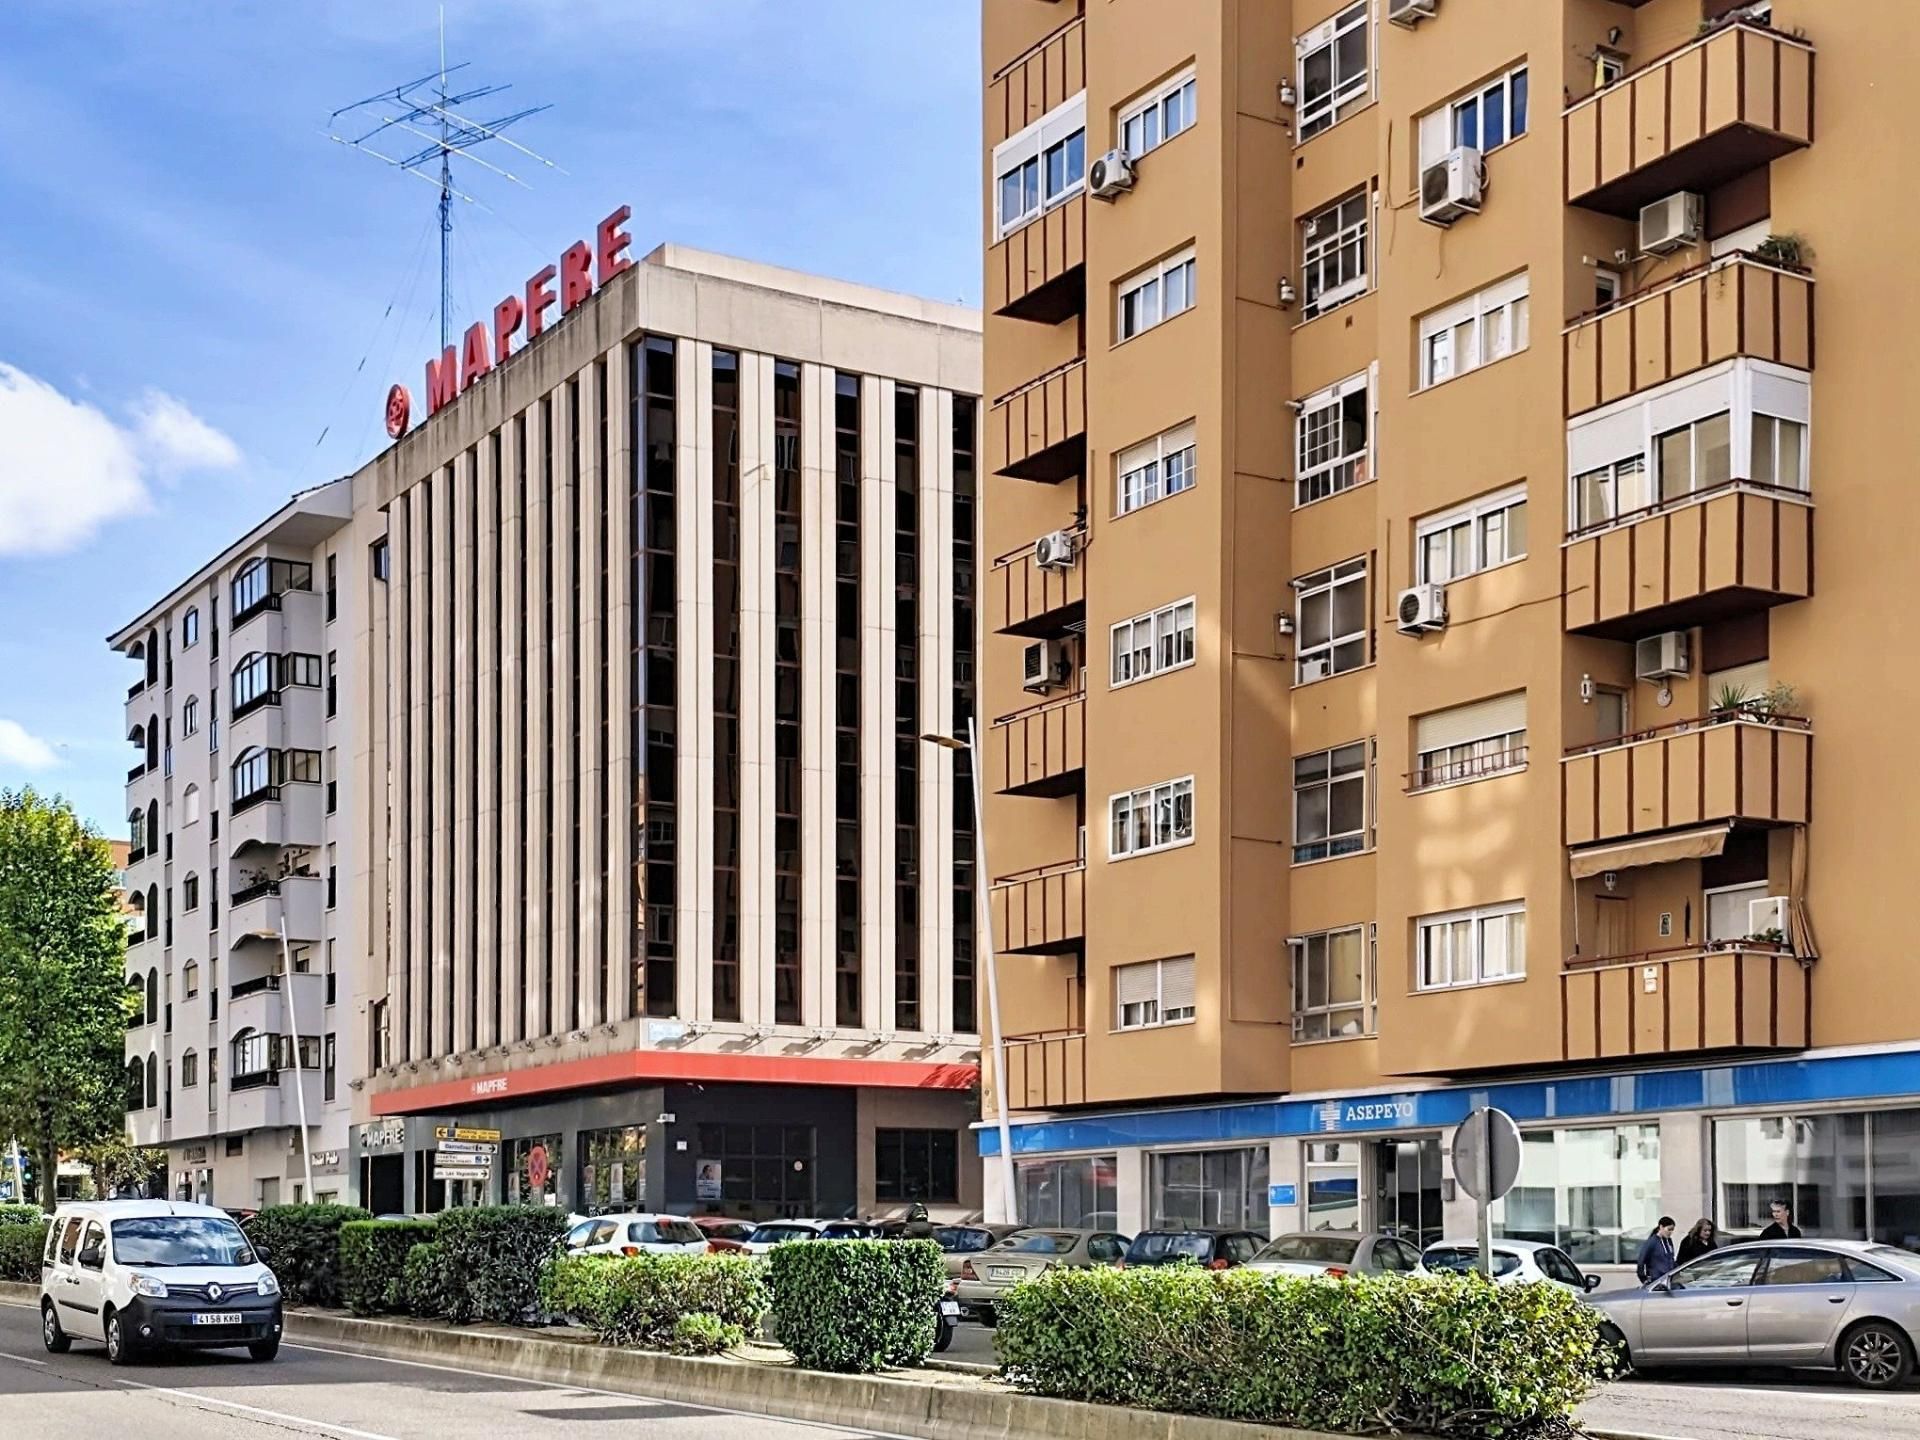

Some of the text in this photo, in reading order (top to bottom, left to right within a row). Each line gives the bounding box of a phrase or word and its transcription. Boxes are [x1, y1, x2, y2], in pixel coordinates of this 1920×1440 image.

[425, 204, 632, 418] MAPFRE
[476, 1077, 508, 1095] MAPFRE
[1345, 1102, 1414, 1121] ASEPEYO
[367, 1128, 404, 1147] MAPFRE
